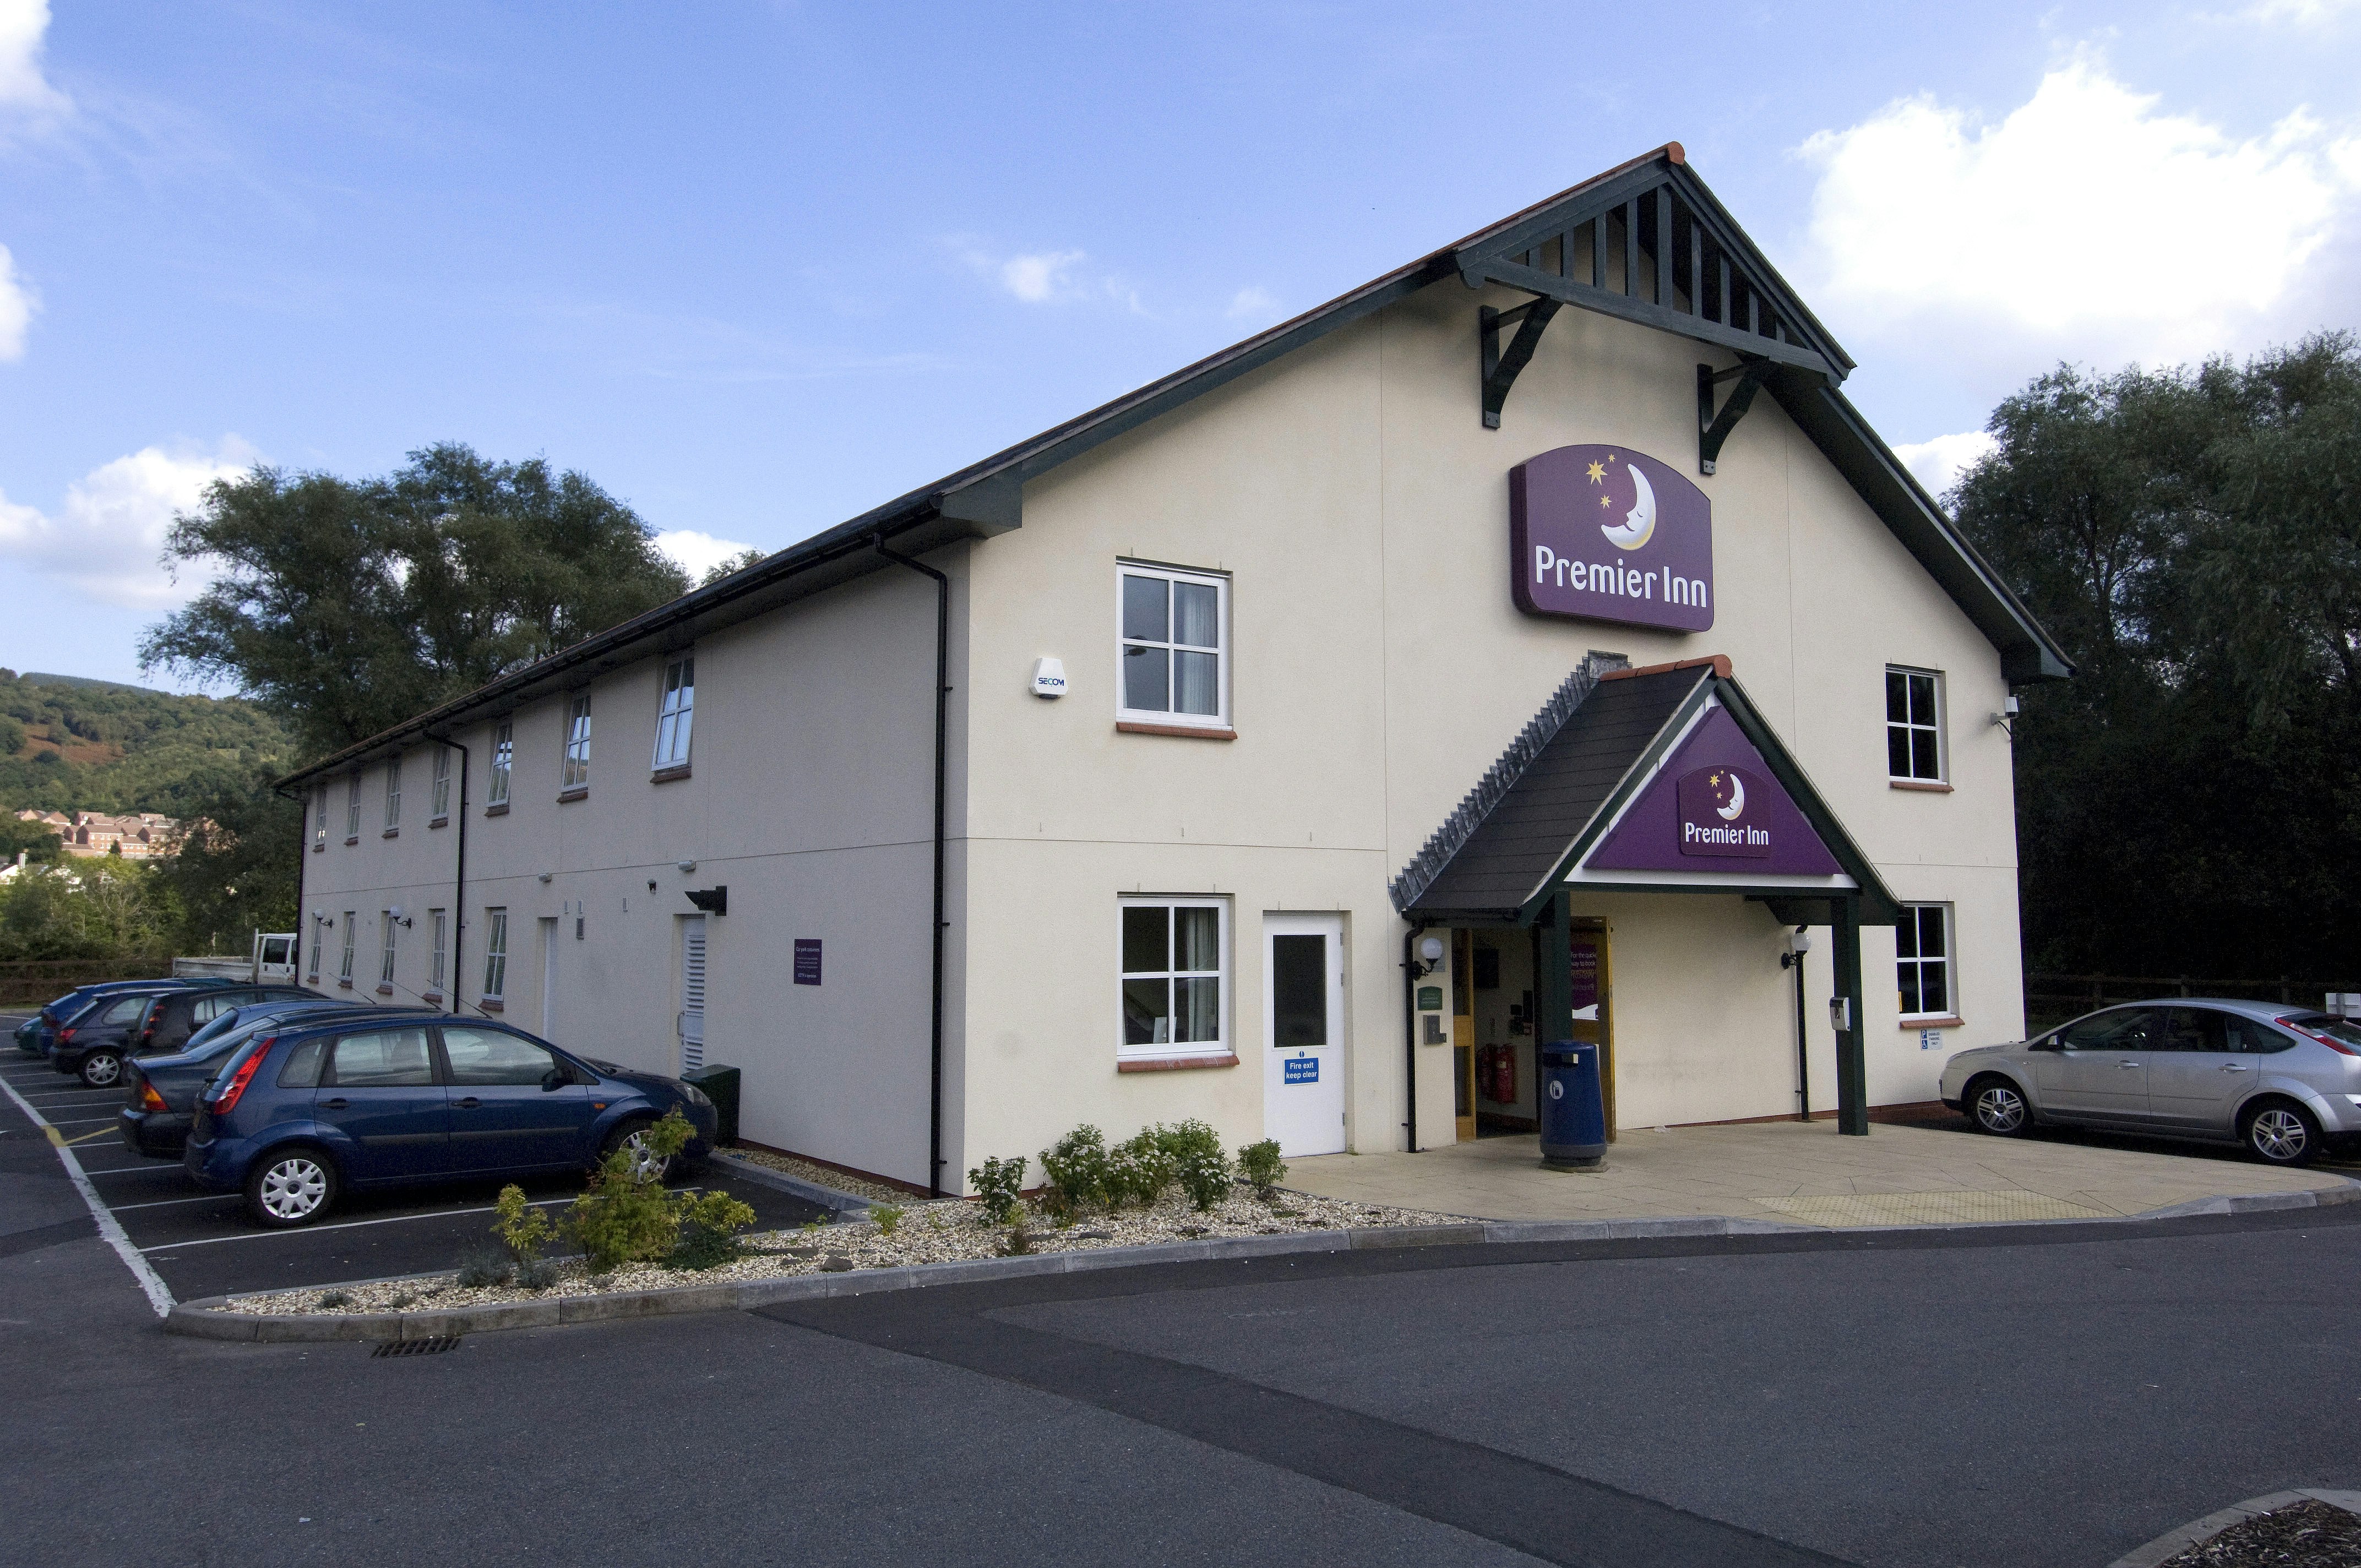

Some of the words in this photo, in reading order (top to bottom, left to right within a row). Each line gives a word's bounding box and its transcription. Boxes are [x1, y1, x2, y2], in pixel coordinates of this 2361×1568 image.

[1536, 545, 1657, 599] Premier
[1663, 566, 1707, 608] Inn
[1038, 677, 1064, 687] SECOM
[1685, 822, 1745, 845] Premier
[1747, 825, 1769, 845] Inn
[1286, 1072, 1301, 1080] keep
